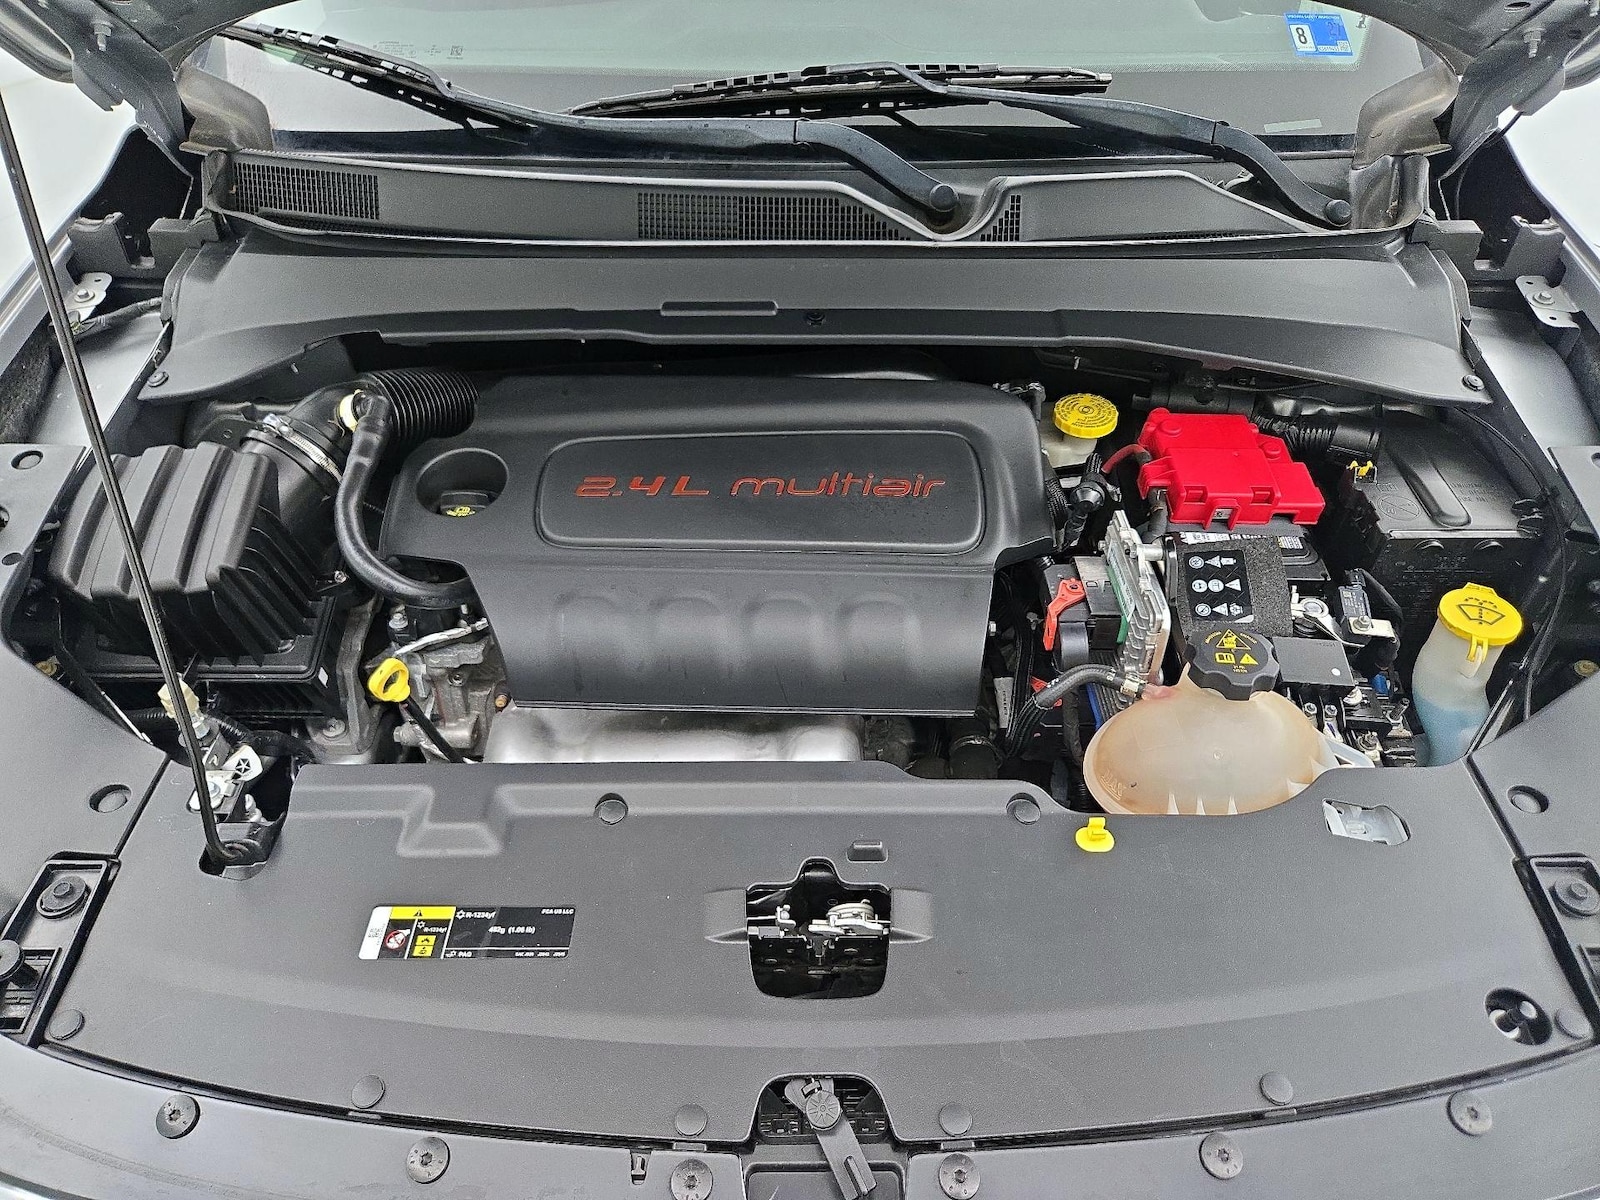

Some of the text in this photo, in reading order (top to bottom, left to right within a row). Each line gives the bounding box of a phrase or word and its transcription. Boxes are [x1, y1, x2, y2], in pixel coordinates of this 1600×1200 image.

[1296, 27, 1307, 44] 8
[576, 471, 946, 498] 2.4L multiair
[465, 911, 496, 919] R-1234yf
